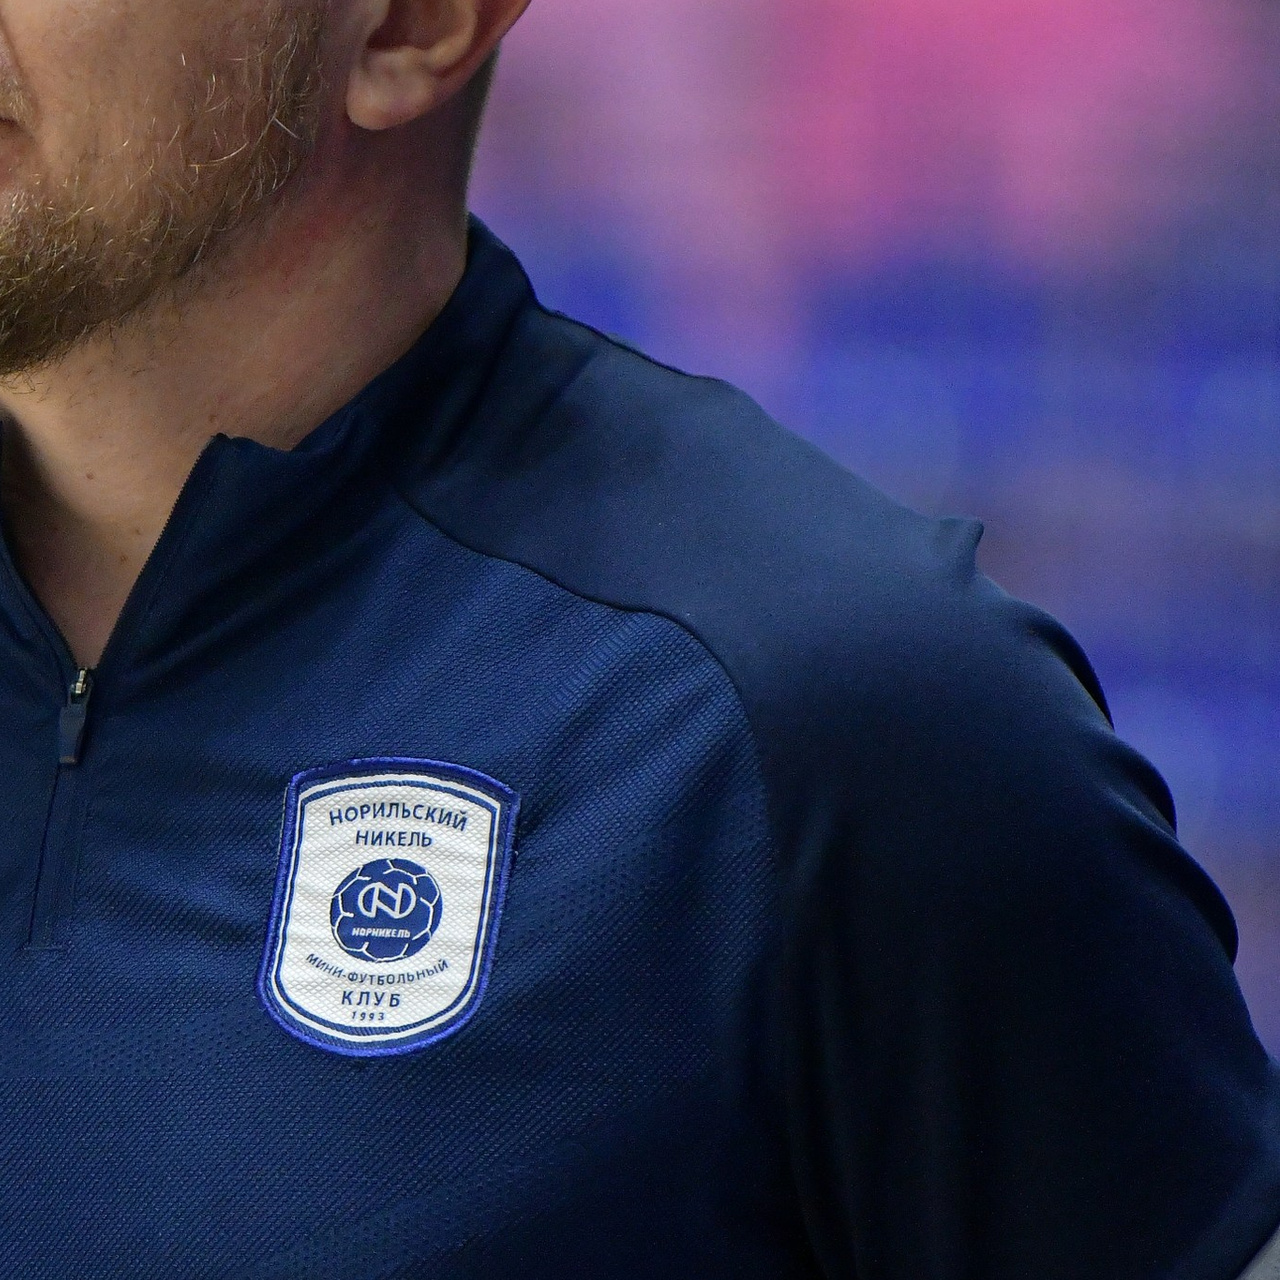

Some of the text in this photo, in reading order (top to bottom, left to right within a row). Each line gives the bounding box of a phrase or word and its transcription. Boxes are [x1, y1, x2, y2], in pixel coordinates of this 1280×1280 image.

[329, 801, 468, 832] НОРИЛЬСКИЙ
[355, 830, 433, 848] НИКЕЛЬ
[351, 927, 411, 939] НОРНИКЕЛЬ
[305, 953, 449, 986] МИНИ-ФУТБОЛЬНЫЙ
[341, 990, 401, 1008] КЛУБ
[351, 1011, 385, 1021] 1993
